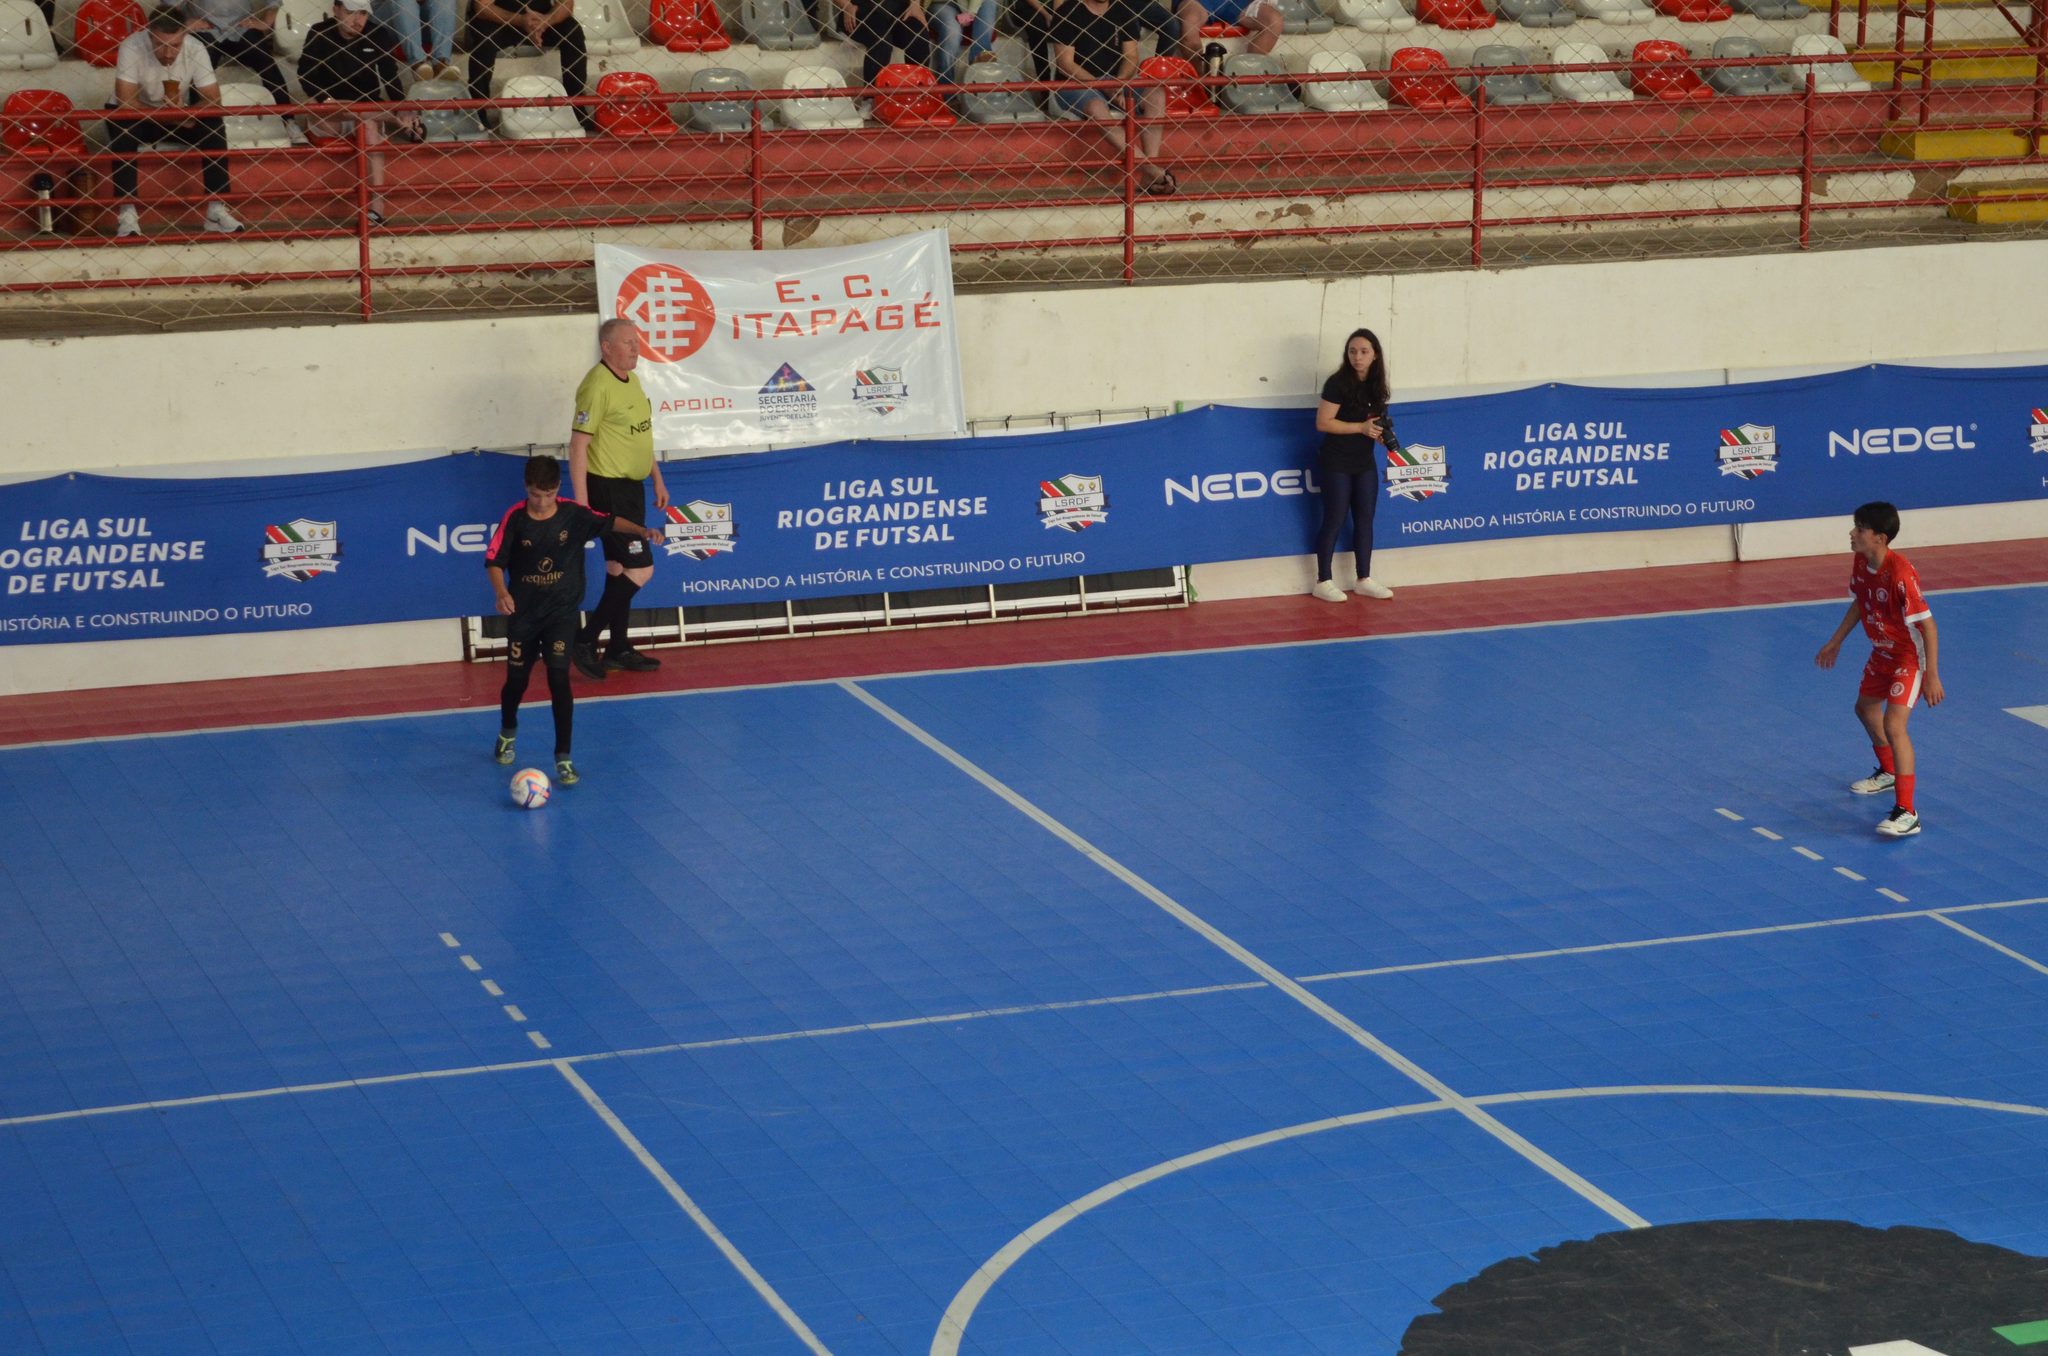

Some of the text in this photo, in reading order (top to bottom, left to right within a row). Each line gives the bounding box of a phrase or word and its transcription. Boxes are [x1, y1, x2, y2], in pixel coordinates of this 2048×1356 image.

[775, 274, 889, 303] E. C.
[732, 292, 941, 340] ITAPAGÉ
[758, 394, 817, 405] SECRETARIA
[867, 386, 893, 394] LSRDF
[659, 397, 733, 412] APOIO:
[1525, 422, 1627, 443] LIGA SUL
[1484, 443, 1669, 470] RIOGRANDENSE
[1733, 446, 1763, 456] LSRDF
[1400, 467, 1433, 477] LSRDF
[1516, 467, 1638, 491] DE FUTSAL
[824, 476, 939, 501] LIGA SUL
[778, 497, 987, 528] RIOGRANDENSE
[1055, 496, 1091, 507] LSRDF
[1402, 499, 1754, 533] HONRANDO A HISTÓRIA E CONSTRUINDO O FUTURO
[21, 518, 151, 541] LIGA SUL
[680, 525, 718, 534] LSRDF
[815, 524, 954, 550] DE FUTSAL
[281, 544, 320, 555] LSRDF
[8, 569, 164, 594] DE FUTSAL
[683, 552, 1085, 592] HONRANDO A HISTÓRIA E CONSTRUINDO O FUTURO
[76, 616, 84, 627] E
[90, 609, 219, 626] CONSTRUINDO
[225, 608, 238, 619] O
[244, 603, 312, 618] FUTURO
[511, 641, 522, 658] 5
